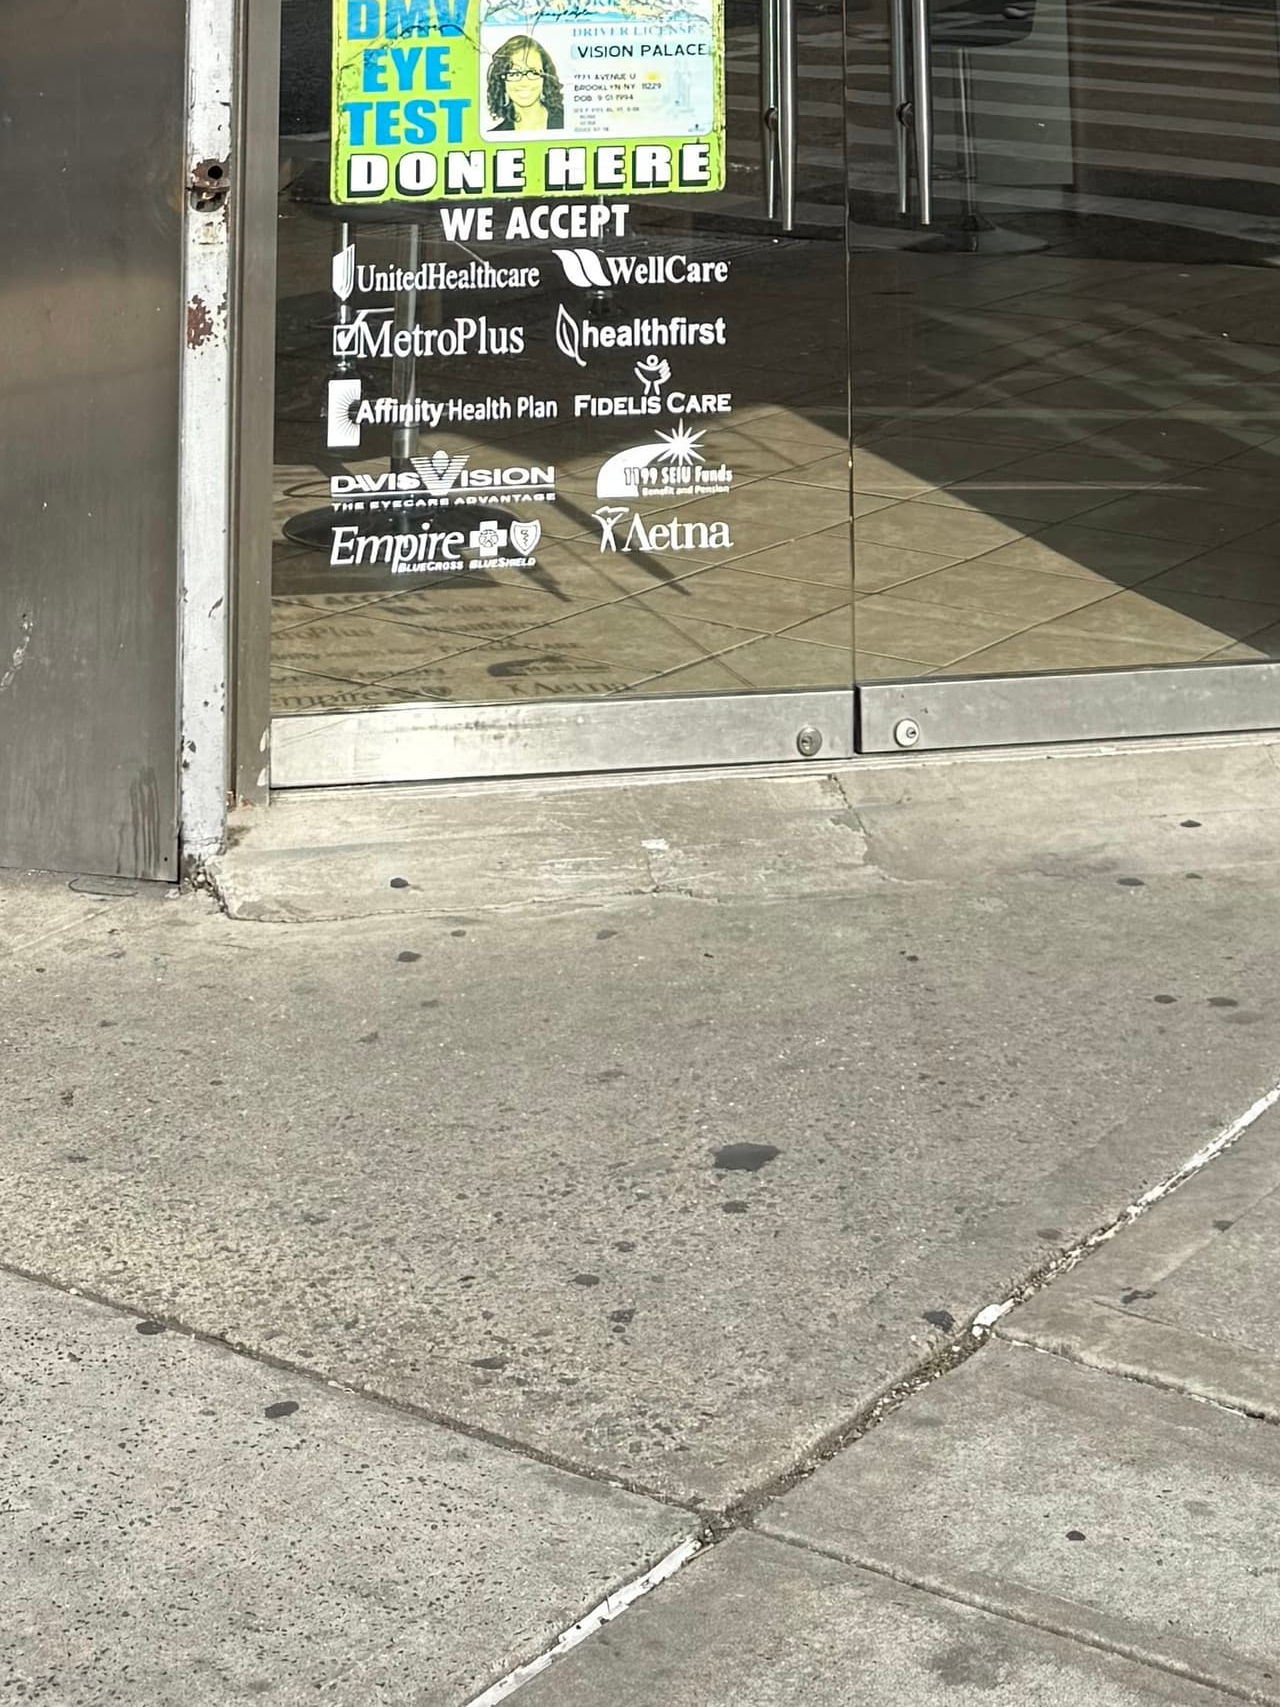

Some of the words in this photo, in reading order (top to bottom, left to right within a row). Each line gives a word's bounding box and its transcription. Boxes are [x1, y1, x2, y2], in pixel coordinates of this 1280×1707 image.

[572, 26, 629, 38] DRIVER
[577, 45, 634, 59] VISION
[640, 44, 708, 57] PALACE
[362, 47, 451, 93] EYE
[594, 73, 627, 81] AVENUE
[573, 83, 621, 92] BROOKLYN
[342, 99, 473, 147] TEST
[346, 148, 527, 198] DONE
[544, 143, 713, 192] HERE
[440, 208, 494, 241] WE
[506, 205, 630, 240] ACCEPT
[357, 261, 541, 294] UnitedHealthcare
[607, 255, 729, 286] WellCare
[357, 317, 525, 358] MetroPlus
[582, 317, 727, 349] healthfirst
[357, 399, 444, 428] Affinity
[448, 398, 511, 421] Health
[516, 396, 558, 420] Plan
[574, 394, 661, 418] FIDELIS
[666, 392, 733, 414] CARE
[623, 466, 658, 486] 1199
[661, 465, 692, 484] SEIU
[694, 463, 733, 483] Funds
[331, 501, 368, 512] THE
[370, 497, 450, 511] EYECARE
[454, 493, 556, 506] ADVANTAGE
[641, 486, 671, 496] Benefit
[671, 486, 693, 495] and
[693, 484, 731, 494] Pension
[330, 521, 464, 574] Empire
[622, 514, 734, 553] Aetna
